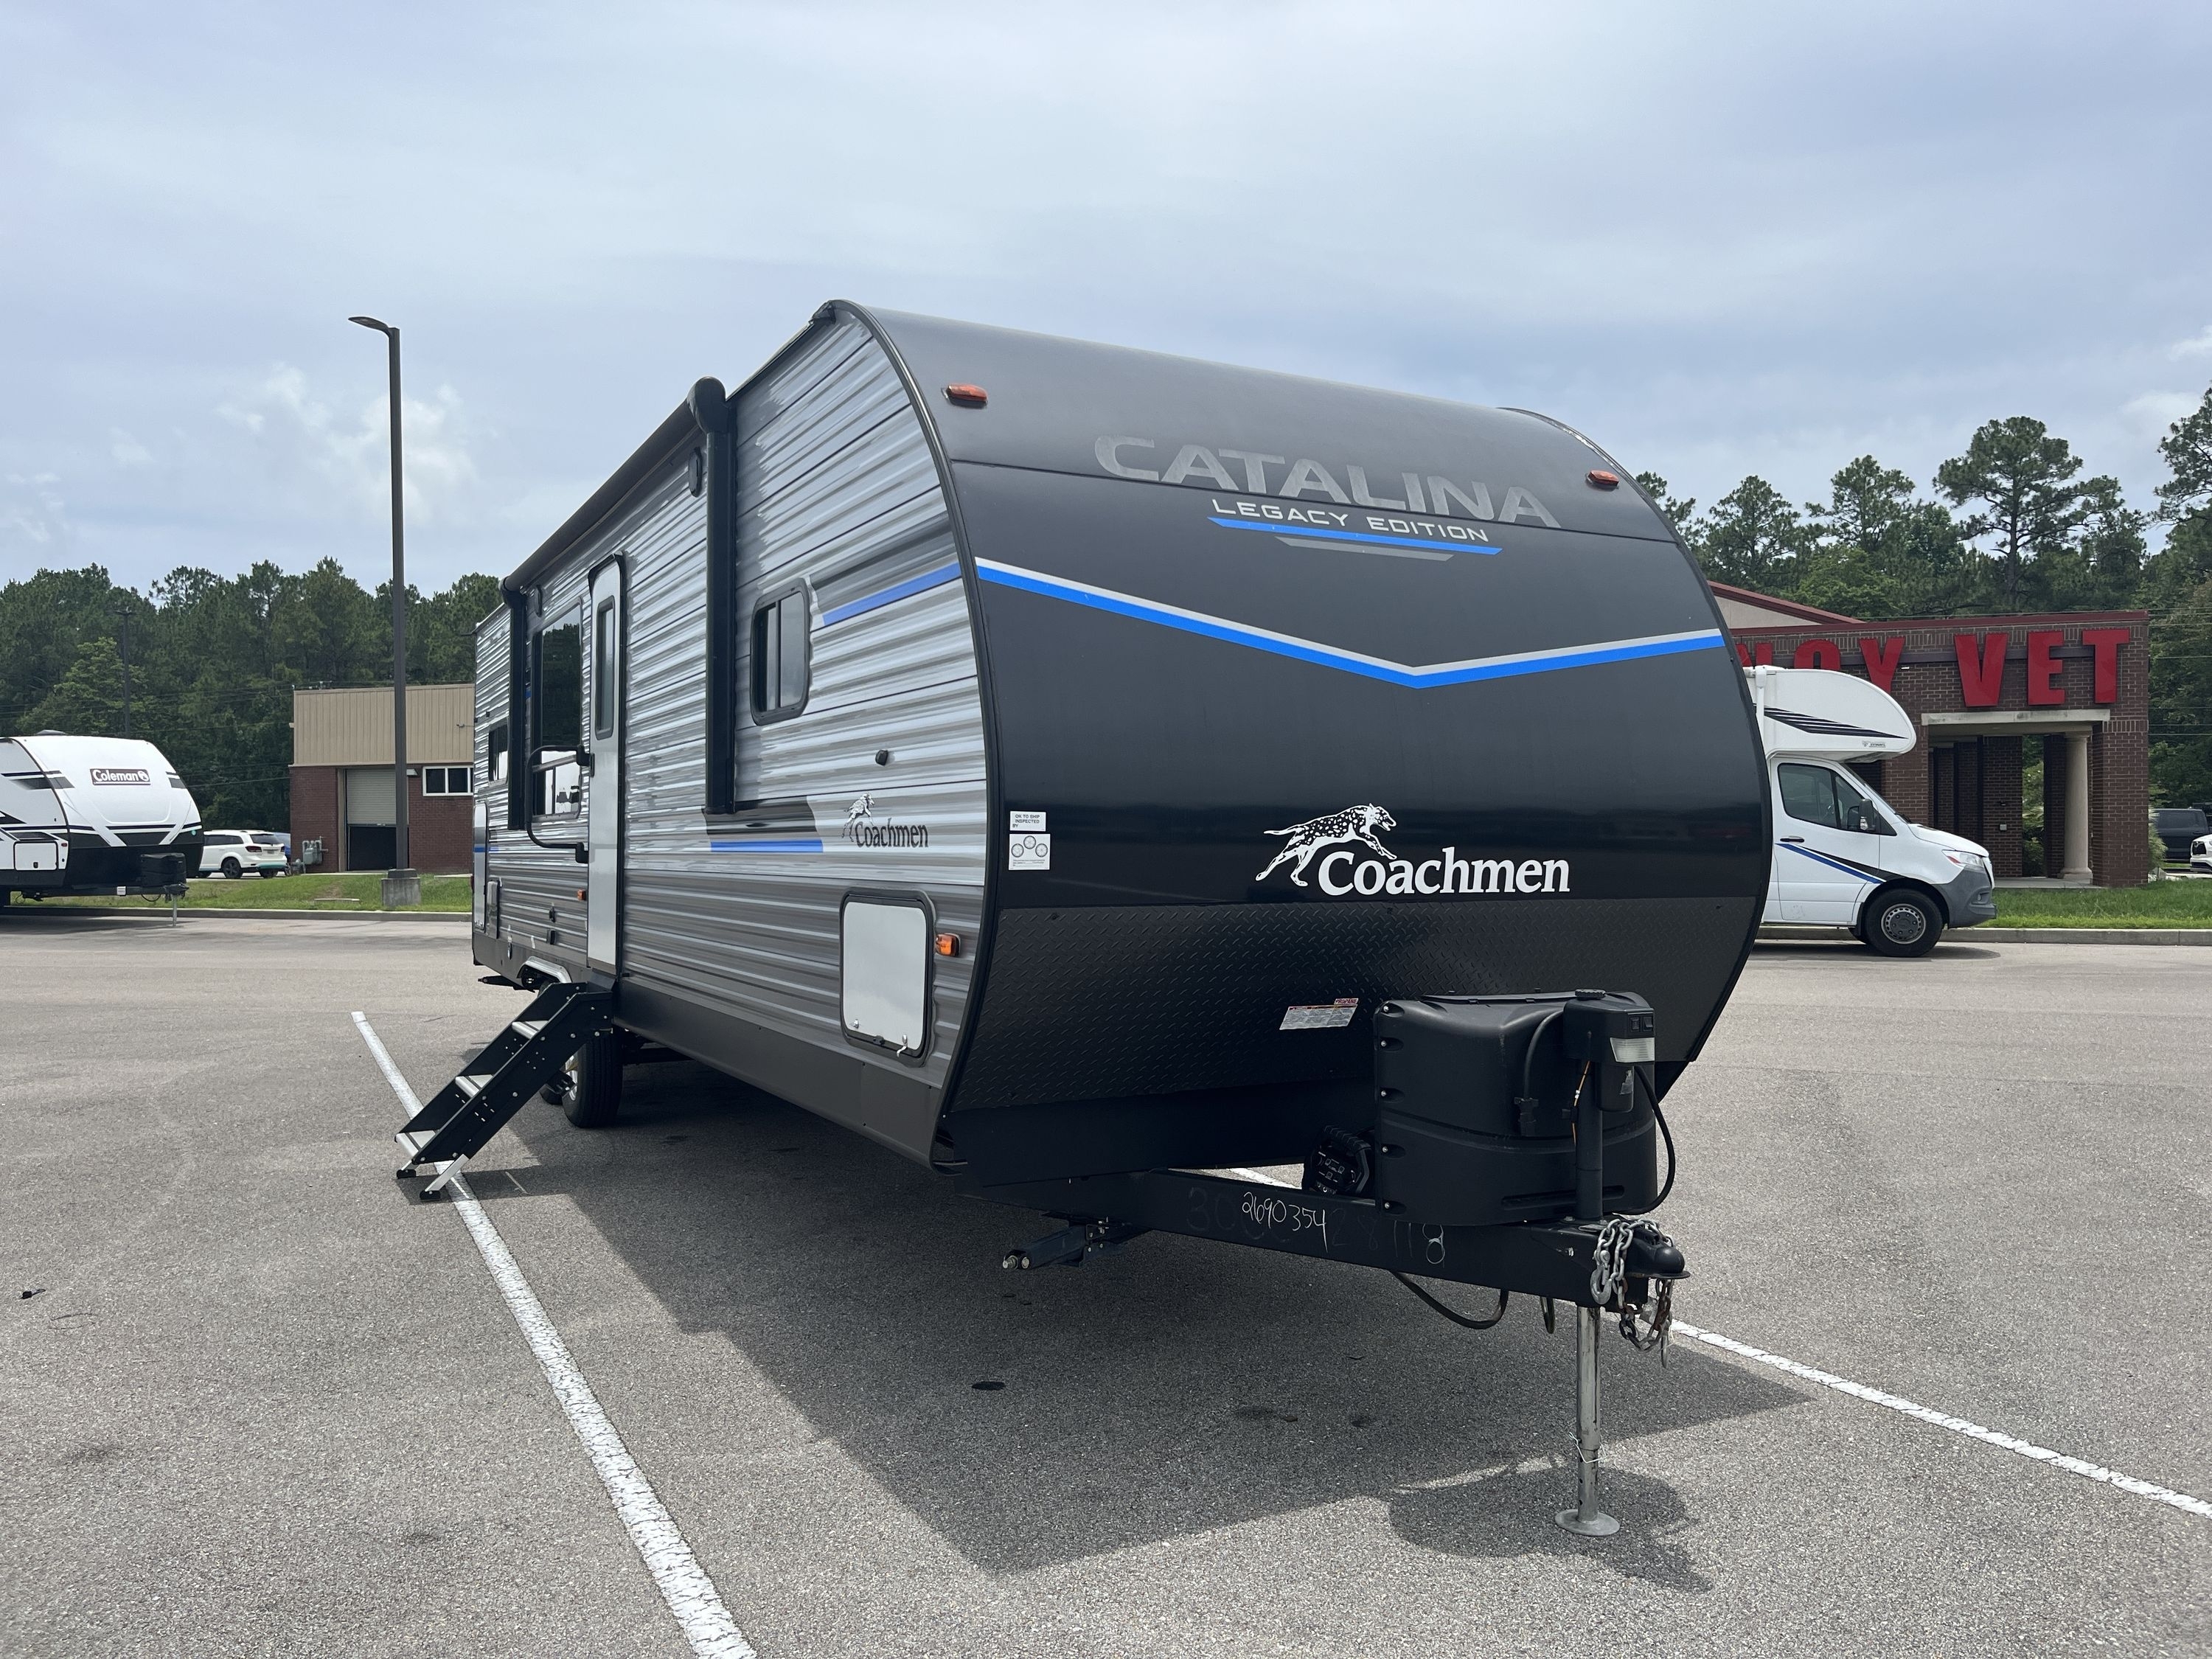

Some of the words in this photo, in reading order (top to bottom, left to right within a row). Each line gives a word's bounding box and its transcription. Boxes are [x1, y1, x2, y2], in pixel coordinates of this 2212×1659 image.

[1094, 434, 1562, 529] CATALINA
[1211, 498, 1349, 527] LEGACY
[1366, 516, 1489, 543] EDITION
[1953, 627, 2130, 707] VET
[92, 769, 139, 782] Coleman
[855, 817, 930, 849] Coachmen
[1318, 846, 1571, 897] Coachmen
[1241, 1191, 1328, 1253] 2690354
